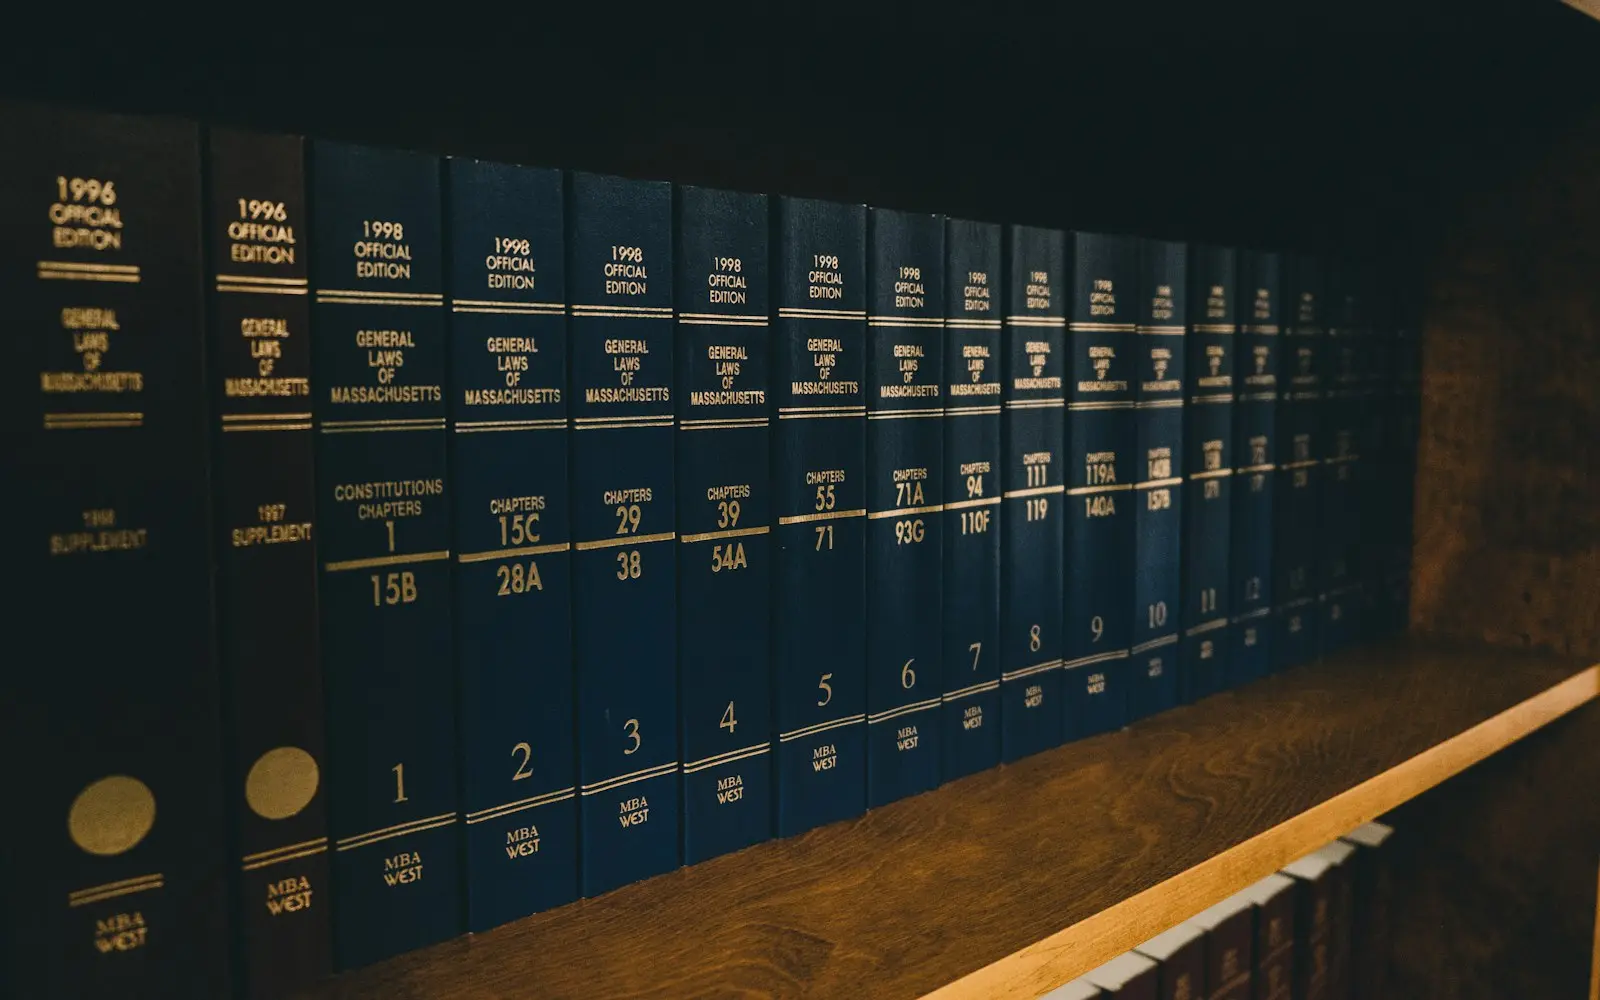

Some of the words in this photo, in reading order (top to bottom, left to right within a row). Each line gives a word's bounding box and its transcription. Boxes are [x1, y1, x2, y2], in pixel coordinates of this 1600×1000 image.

[57, 176, 116, 205] 1996
[238, 199, 286, 221] 1996
[53, 227, 121, 250] EDITION
[228, 222, 295, 244] OFFICIAL
[362, 220, 404, 240] 1998
[231, 243, 295, 264] EDITION
[353, 241, 412, 261] OFFICIAL
[494, 237, 530, 255] 1998
[611, 245, 642, 262] 1998
[486, 255, 536, 273] OFFICIAL
[604, 262, 647, 279] OFFICIAL
[714, 256, 741, 272] 1998
[813, 254, 839, 270] 1998
[357, 262, 410, 280] EDITION
[808, 270, 843, 285] OFFICIAL
[899, 266, 920, 281] 1998
[968, 272, 986, 285] 1998
[1031, 272, 1048, 283] 1998
[488, 274, 535, 290] EDITION
[606, 280, 646, 295] EDITION
[708, 273, 747, 289] OFFICIAL
[895, 281, 925, 295] OFFICIAL
[709, 289, 746, 304] EDITION
[809, 285, 842, 300] EDITION
[964, 285, 990, 299] OFFICIAL
[895, 296, 924, 309] EDITION
[964, 299, 989, 312] EDITION
[1026, 298, 1050, 309] EDITION
[241, 318, 289, 338] GENERAL
[356, 330, 415, 347] GENERAL
[487, 337, 538, 353] GENERAL
[605, 339, 649, 354] GENERAL
[807, 338, 843, 352] GENERAL
[251, 340, 281, 358] LAWS
[708, 346, 748, 360] GENERAL
[894, 345, 924, 358] GENERAL
[963, 346, 990, 358] GENERAL
[368, 350, 403, 367] LAWS
[497, 355, 528, 371] LAWS
[614, 356, 640, 371] LAWS
[814, 354, 836, 368] LAWS
[899, 359, 918, 372] LAWS
[968, 358, 984, 372] LAWS
[259, 360, 273, 376] OF
[378, 367, 395, 383] OF
[716, 362, 740, 376] LAWS
[820, 366, 830, 380] OF
[506, 371, 521, 387] OF
[620, 370, 634, 386] OF
[722, 376, 734, 390] OF
[903, 372, 913, 384] OF
[972, 371, 980, 383] OF
[225, 378, 309, 396] MASSACHUSETTS
[330, 386, 441, 403] MASSACHUSETTS
[585, 386, 669, 402] MASSACHUSETTS
[791, 381, 858, 396] MASSACHUSETTS
[881, 384, 939, 398] MASSACHUSETTS
[951, 382, 1001, 396] MASSACHUSETTS
[465, 388, 561, 405] MASSACHUSETTS
[691, 390, 765, 406] MASSACHUSETTS
[806, 470, 845, 484] CHAPTERS
[893, 468, 927, 482] CHAPTERS
[960, 462, 990, 476] CHAPTERS
[1027, 464, 1047, 486] 111
[1086, 463, 1116, 485] 119A
[335, 479, 444, 501] CONSTITUTIONS
[707, 484, 750, 501] CHAPTERS
[896, 482, 925, 506] 71A
[966, 475, 983, 498] 94
[490, 495, 546, 514] CHAPTERS
[603, 488, 652, 506] CHAPTERS
[815, 484, 836, 511] 55
[358, 500, 422, 520] CHAPTERS
[717, 500, 740, 528] 39
[1026, 499, 1048, 522] 119
[1085, 496, 1116, 518] 140A
[615, 504, 642, 535] 29
[960, 510, 990, 536] 110F
[232, 522, 311, 546] SUPPLEMENT
[385, 521, 396, 552] 1
[499, 513, 541, 546] 15C
[895, 519, 925, 546] 93G
[815, 525, 834, 552] 71
[616, 550, 642, 581] 38
[712, 544, 748, 572] 54A
[497, 561, 543, 597] 28A
[370, 571, 417, 607] 15B
[1149, 601, 1167, 628] 10
[1030, 624, 1041, 651] 8
[1091, 616, 1103, 642] 9
[969, 642, 982, 670] 7
[901, 658, 916, 688] 6
[817, 672, 833, 706] 5
[1025, 685, 1042, 697] MBA
[1024, 694, 1043, 708] WEST
[719, 701, 738, 734] 4
[964, 706, 983, 718] MBA
[962, 716, 983, 730] WEST
[623, 718, 641, 755] 3
[897, 726, 918, 739] MBA
[813, 744, 836, 759] MBA
[896, 736, 919, 751] WEST
[511, 741, 534, 781] 2
[812, 755, 837, 772] WEST
[392, 763, 408, 803] 1
[717, 775, 743, 792] MBA
[716, 786, 744, 804] WEST
[619, 796, 648, 814] MBA
[619, 809, 649, 828] WEST
[506, 825, 539, 844] MBA
[505, 838, 541, 860] WEST
[384, 851, 421, 871] MBA
[383, 865, 424, 887] WEST
[267, 875, 311, 900] MBA
[266, 890, 312, 917] WEST
[96, 911, 145, 936] MBA
[94, 927, 148, 954] WEST
